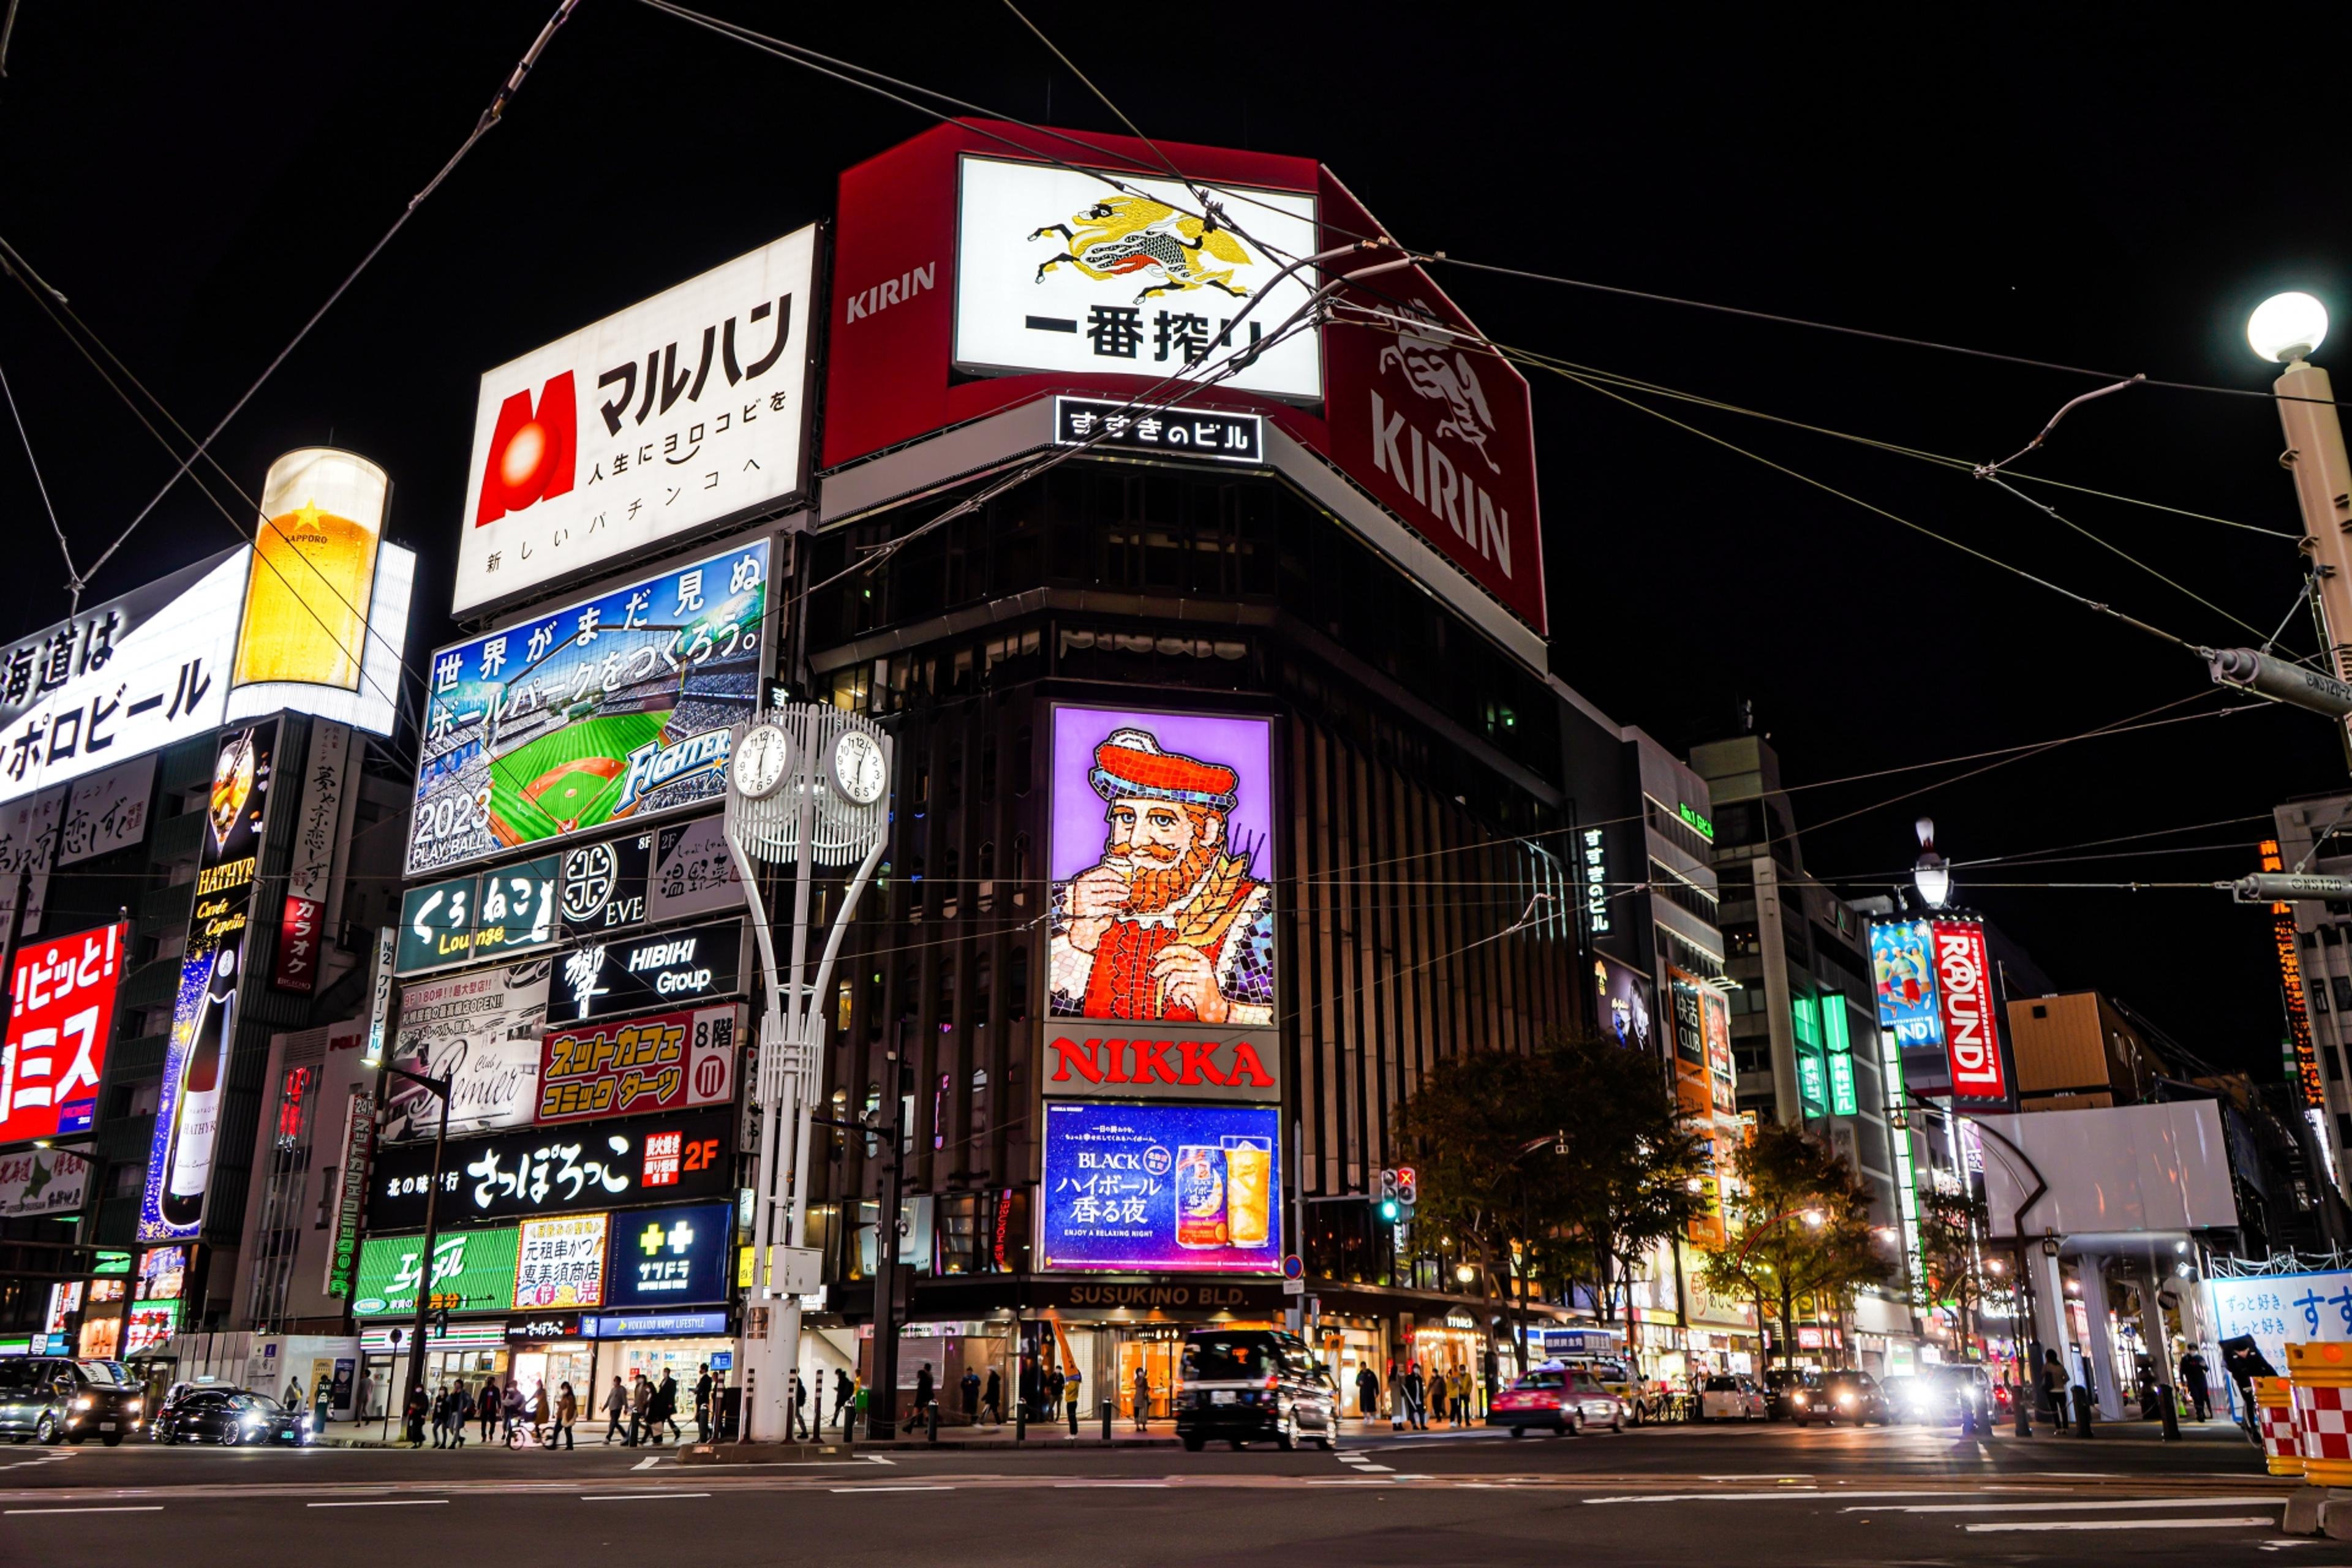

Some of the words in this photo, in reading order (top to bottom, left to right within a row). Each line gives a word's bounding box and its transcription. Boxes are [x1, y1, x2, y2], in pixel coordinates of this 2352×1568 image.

[846, 261, 935, 325] KIRIN
[1025, 304, 1262, 368] 一番搾り
[597, 292, 791, 437] マルハン
[588, 391, 787, 486] 人生にヨロコビを
[1070, 410, 1248, 451] すすきのビル
[1370, 388, 1512, 580] KIRIN
[486, 459, 760, 574] 新しいパチンコへ
[284, 535, 328, 544] SAPPORO
[436, 554, 761, 695] 世界がまだ見ぬ
[429, 614, 755, 743] ボールパークをつくろう。
[612, 726, 733, 815] FIGHTER
[415, 788, 492, 845] 2023
[413, 843, 448, 864] PLAY
[449, 835, 484, 856] BALL
[638, 837, 651, 850] 8F
[662, 833, 676, 850] 2F
[197, 857, 255, 895] HATHYR
[1585, 829, 1609, 931] すすきのビル
[414, 876, 532, 944] くろねこ
[605, 897, 646, 927] EVE
[288, 901, 314, 973] カラオケ
[439, 926, 504, 954] Lounge
[628, 939, 696, 972] HIBIKI
[657, 968, 712, 995] Group
[369, 974, 391, 1050] グリーンビル
[404, 995, 416, 1008] 9F
[1676, 994, 1699, 1027] 快活
[1939, 935, 1997, 1083] ROUND1
[1971, 938, 1983, 979] SPORTS
[1977, 981, 1996, 1067] ENTERTAINMENT
[695, 1016, 733, 1050] 8階
[1679, 1027, 1701, 1053] CLUB
[475, 1055, 495, 1072] Club
[546, 1024, 687, 1078] ネットカフェ
[1049, 1036, 1275, 1087] NIKKA
[356, 1098, 374, 1115] 24H
[541, 1077, 614, 1117] コミック
[620, 1068, 682, 1107] ダーツ
[684, 1139, 718, 1171] 2F
[1078, 1152, 1140, 1170] BLACK
[467, 1136, 629, 1208] さっぽろっこ
[1055, 1174, 1162, 1196] ハイボール
[1070, 1196, 1148, 1224] 香る夜
[525, 1238, 593, 1261] 元祖串かつ
[521, 1261, 600, 1284] 恵美須商店
[639, 1260, 690, 1281] サツドラ
[1070, 1286, 1189, 1305] SUSUKINO
[1199, 1288, 1250, 1306] BLD.
[2226, 1294, 2287, 1313] ずっと好き。
[628, 1322, 655, 1330] HOKKAIDO
[656, 1321, 674, 1330] HAPPY
[676, 1319, 705, 1329] LIFESTYLE
[2231, 1318, 2290, 1335] もっと好き。
